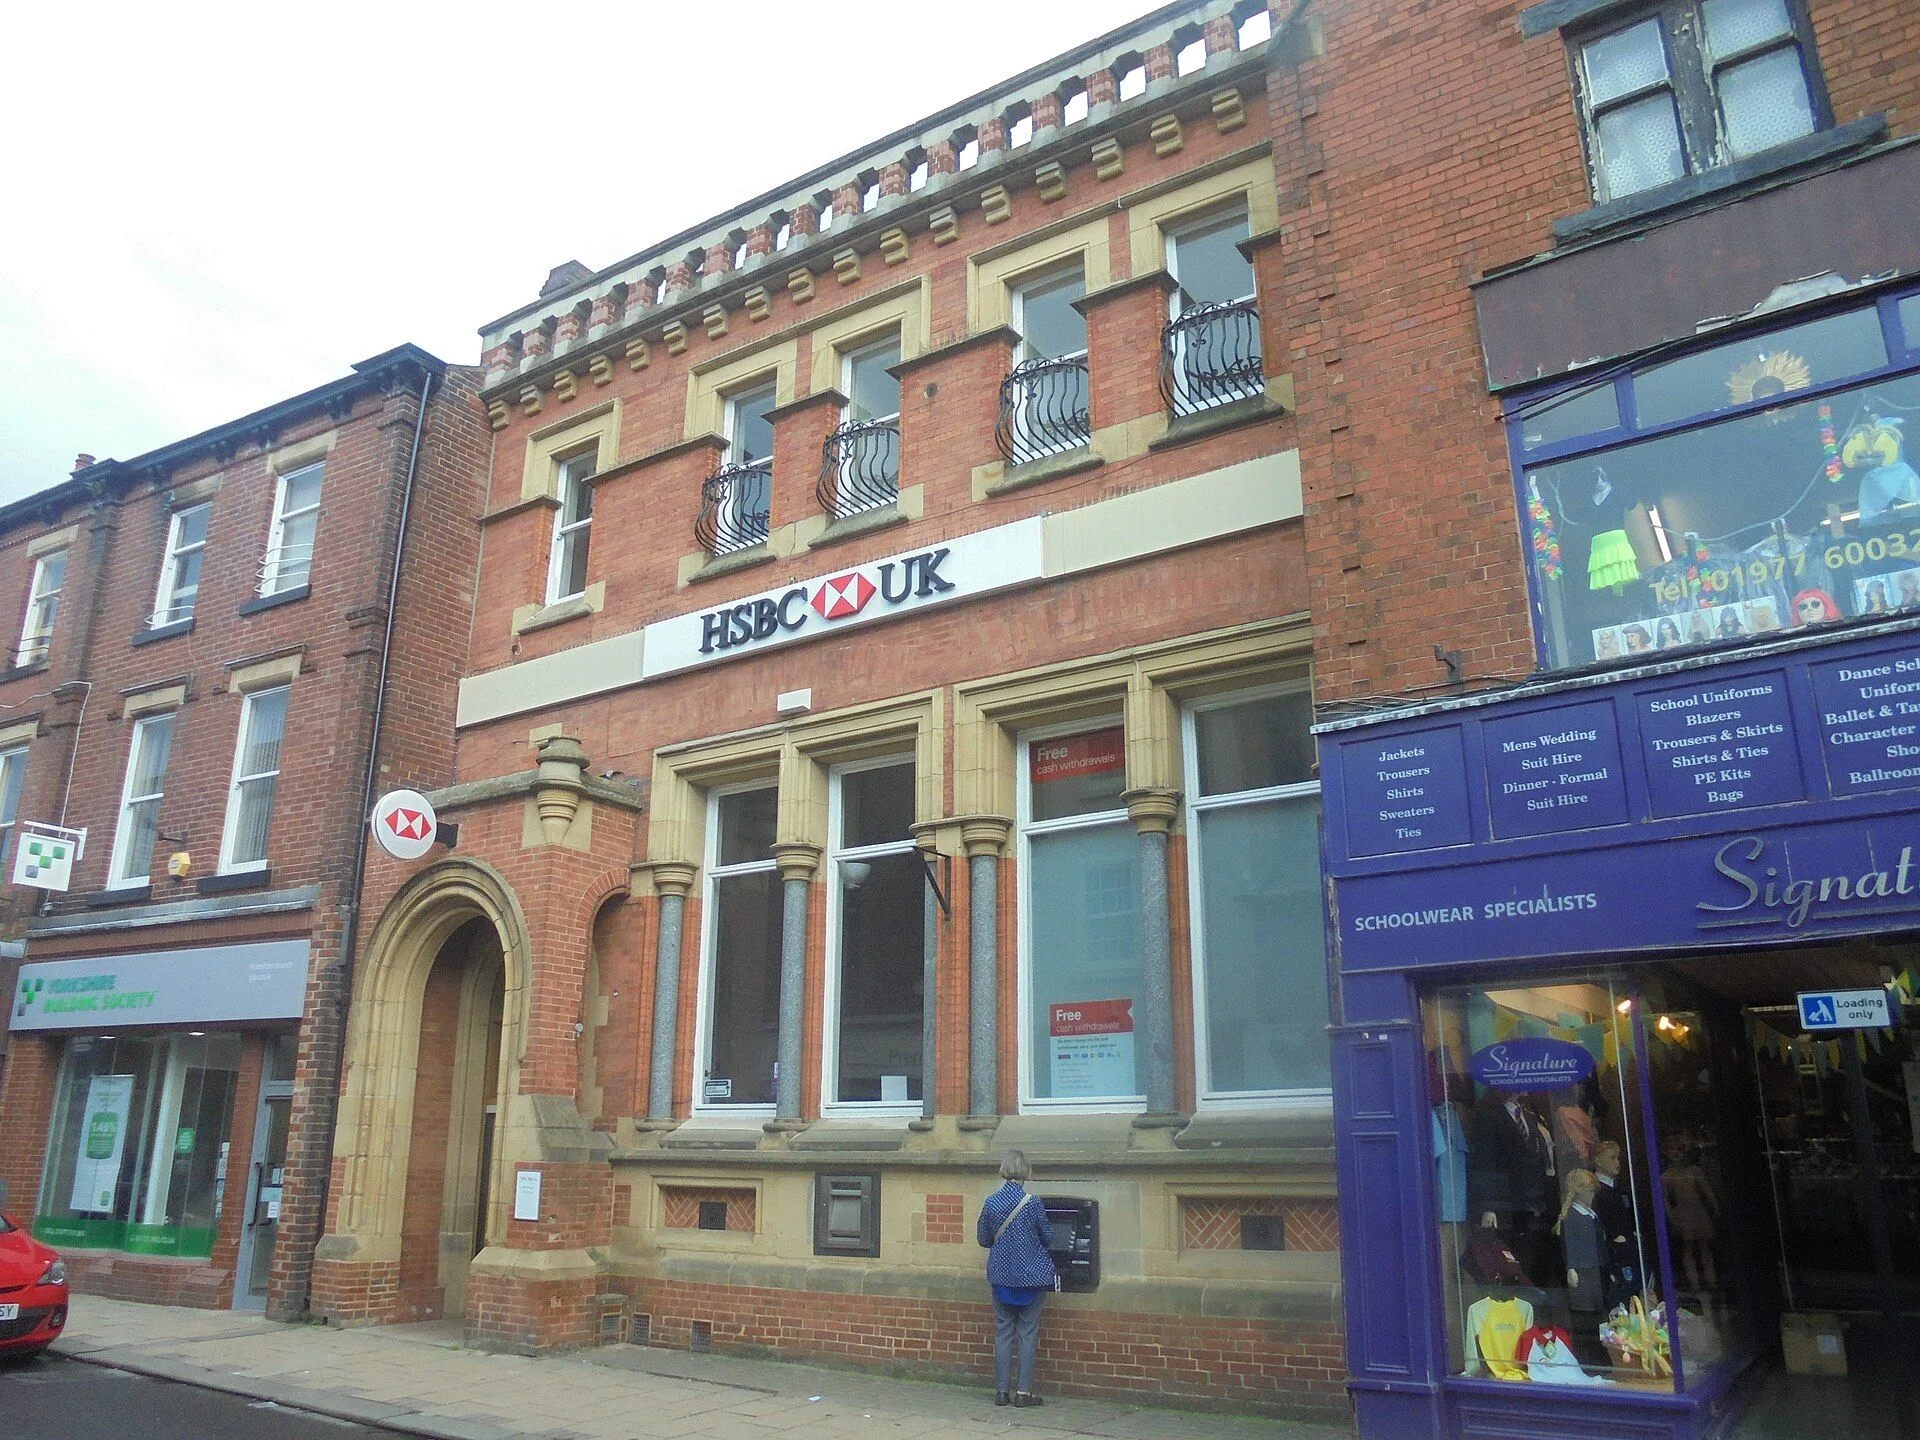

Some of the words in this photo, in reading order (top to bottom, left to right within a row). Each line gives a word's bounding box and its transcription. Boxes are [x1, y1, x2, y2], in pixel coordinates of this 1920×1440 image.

[1711, 551, 1807, 592] 01977
[698, 586, 808, 653] HSBC
[877, 547, 956, 605] UK
[1838, 665, 1891, 682] Dance
[1650, 695, 1699, 713] School
[1701, 685, 1773, 704] Uniforms
[1685, 710, 1741, 727] Blazers
[1824, 708, 1875, 725] Ballet
[1879, 705, 1893, 717] &
[1896, 702, 1920, 717] Ta
[1503, 739, 1537, 753] Mens
[1539, 729, 1597, 748] Wedding
[1652, 733, 1717, 751] Trousers
[1720, 729, 1733, 742] &
[1736, 723, 1784, 739] Skirts
[1830, 725, 1916, 745] Character
[1037, 746, 1068, 762] Free
[1379, 746, 1425, 763] Jackets
[1521, 756, 1549, 771] Suit
[1551, 752, 1583, 767] Hire
[1672, 753, 1717, 768] Shirts
[1720, 749, 1733, 762] &
[1736, 746, 1769, 760] Ties
[1036, 763, 1058, 775] cash
[1059, 753, 1116, 771] withdrawals
[1377, 766, 1430, 782] Trousers
[1502, 778, 1549, 795] Dinner
[1559, 768, 1608, 786] Formal
[1694, 772, 1717, 785] PE
[1720, 769, 1752, 782] Kits
[1386, 786, 1424, 800] Shirts
[1707, 789, 1744, 803] Bags
[1527, 797, 1553, 812] Suit
[1556, 793, 1588, 807] Hire
[1379, 806, 1435, 821] Sweaters
[1395, 826, 1422, 839] Ties
[1354, 906, 1474, 932] SCHOOLWEAR
[1483, 893, 1597, 919] SPECIALISTS
[1836, 998, 1883, 1009] Loading
[1056, 1009, 1081, 1021] Free
[1848, 1009, 1874, 1020] only
[1056, 1023, 1073, 1034] cash
[1074, 1021, 1120, 1033] withdrawals
[1483, 1045, 1578, 1078] Signature
[1489, 1077, 1533, 1086] SCHOOLWEAR
[1533, 1075, 1572, 1084] SPECIALISTS
